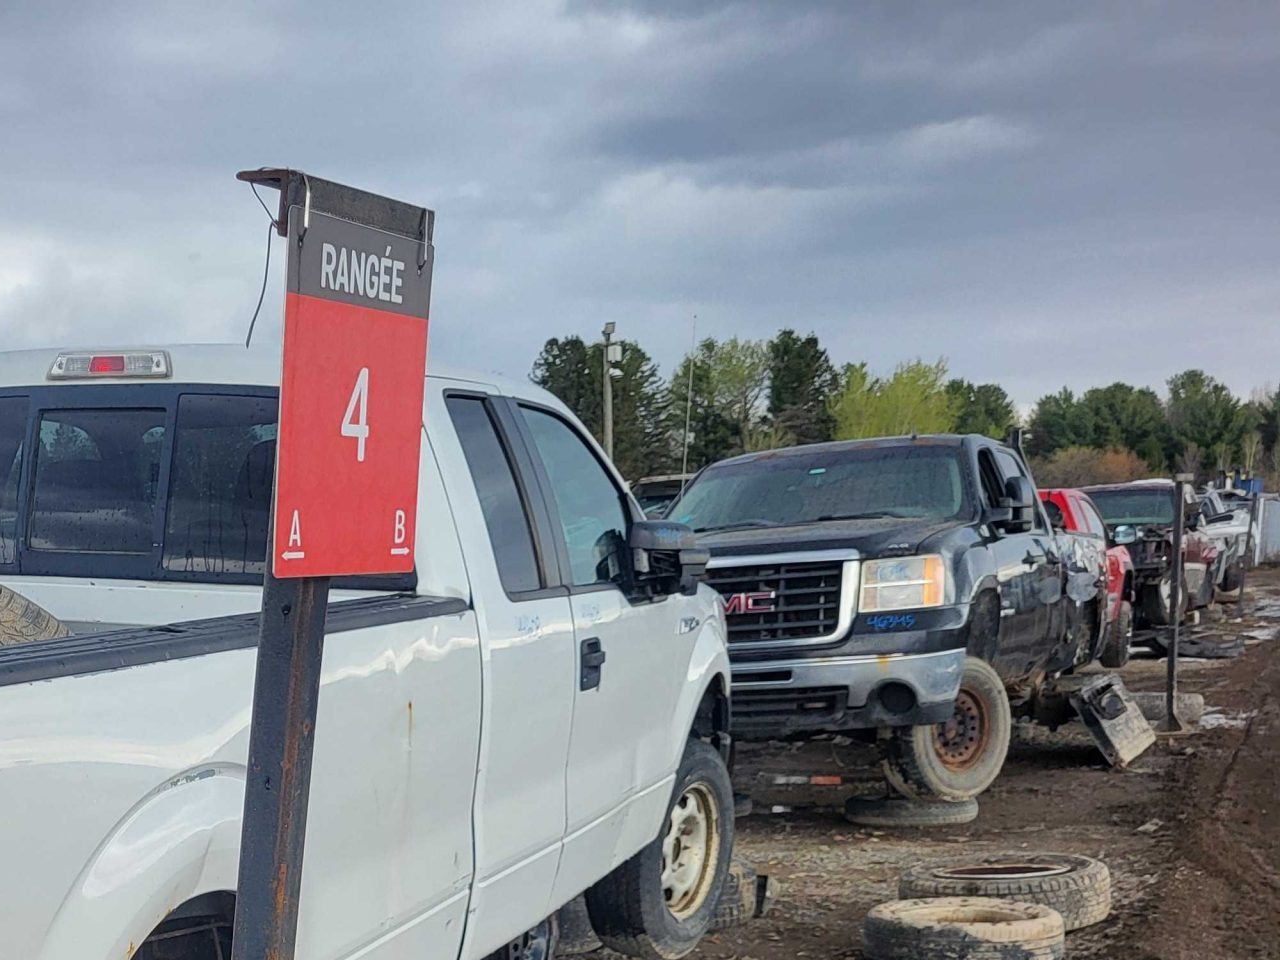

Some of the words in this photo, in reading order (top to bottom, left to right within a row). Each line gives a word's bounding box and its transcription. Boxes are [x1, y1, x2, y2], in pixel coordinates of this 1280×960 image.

[320, 245, 406, 305] RANGÉE
[340, 366, 370, 463] 4
[288, 509, 302, 548] A
[394, 509, 406, 544] B
[720, 591, 776, 615] MC
